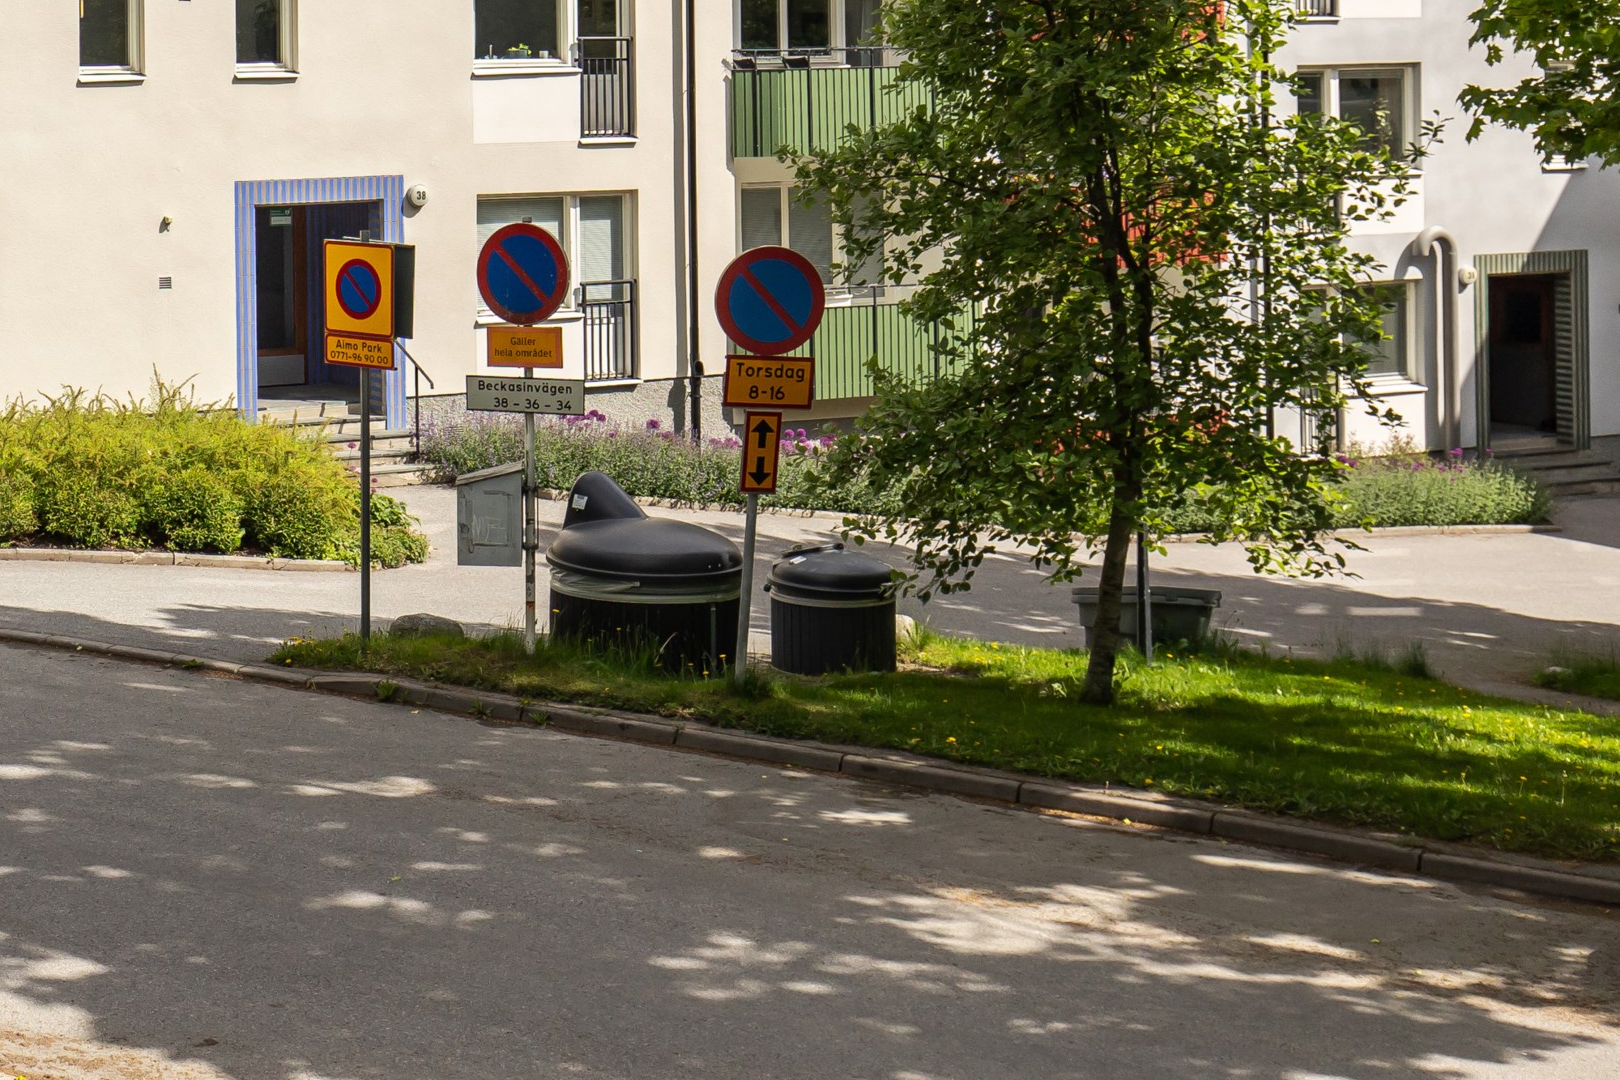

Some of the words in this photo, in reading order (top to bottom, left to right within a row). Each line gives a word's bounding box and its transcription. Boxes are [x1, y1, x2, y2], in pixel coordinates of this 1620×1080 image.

[416, 190, 427, 201] 38
[335, 339, 359, 351] Aimo
[361, 341, 383, 353] Park
[510, 336, 537, 346] Gäller
[330, 350, 362, 362] 0771-96
[364, 354, 375, 363] 90
[376, 355, 389, 364] 00
[494, 348, 513, 357] hela
[515, 348, 552, 358] området
[736, 362, 805, 382] Torsdag
[477, 380, 573, 397] Beckasinvägen
[748, 385, 785, 400] 8-16
[493, 397, 509, 408] 38
[524, 398, 540, 410] 36
[556, 400, 572, 411] 34
